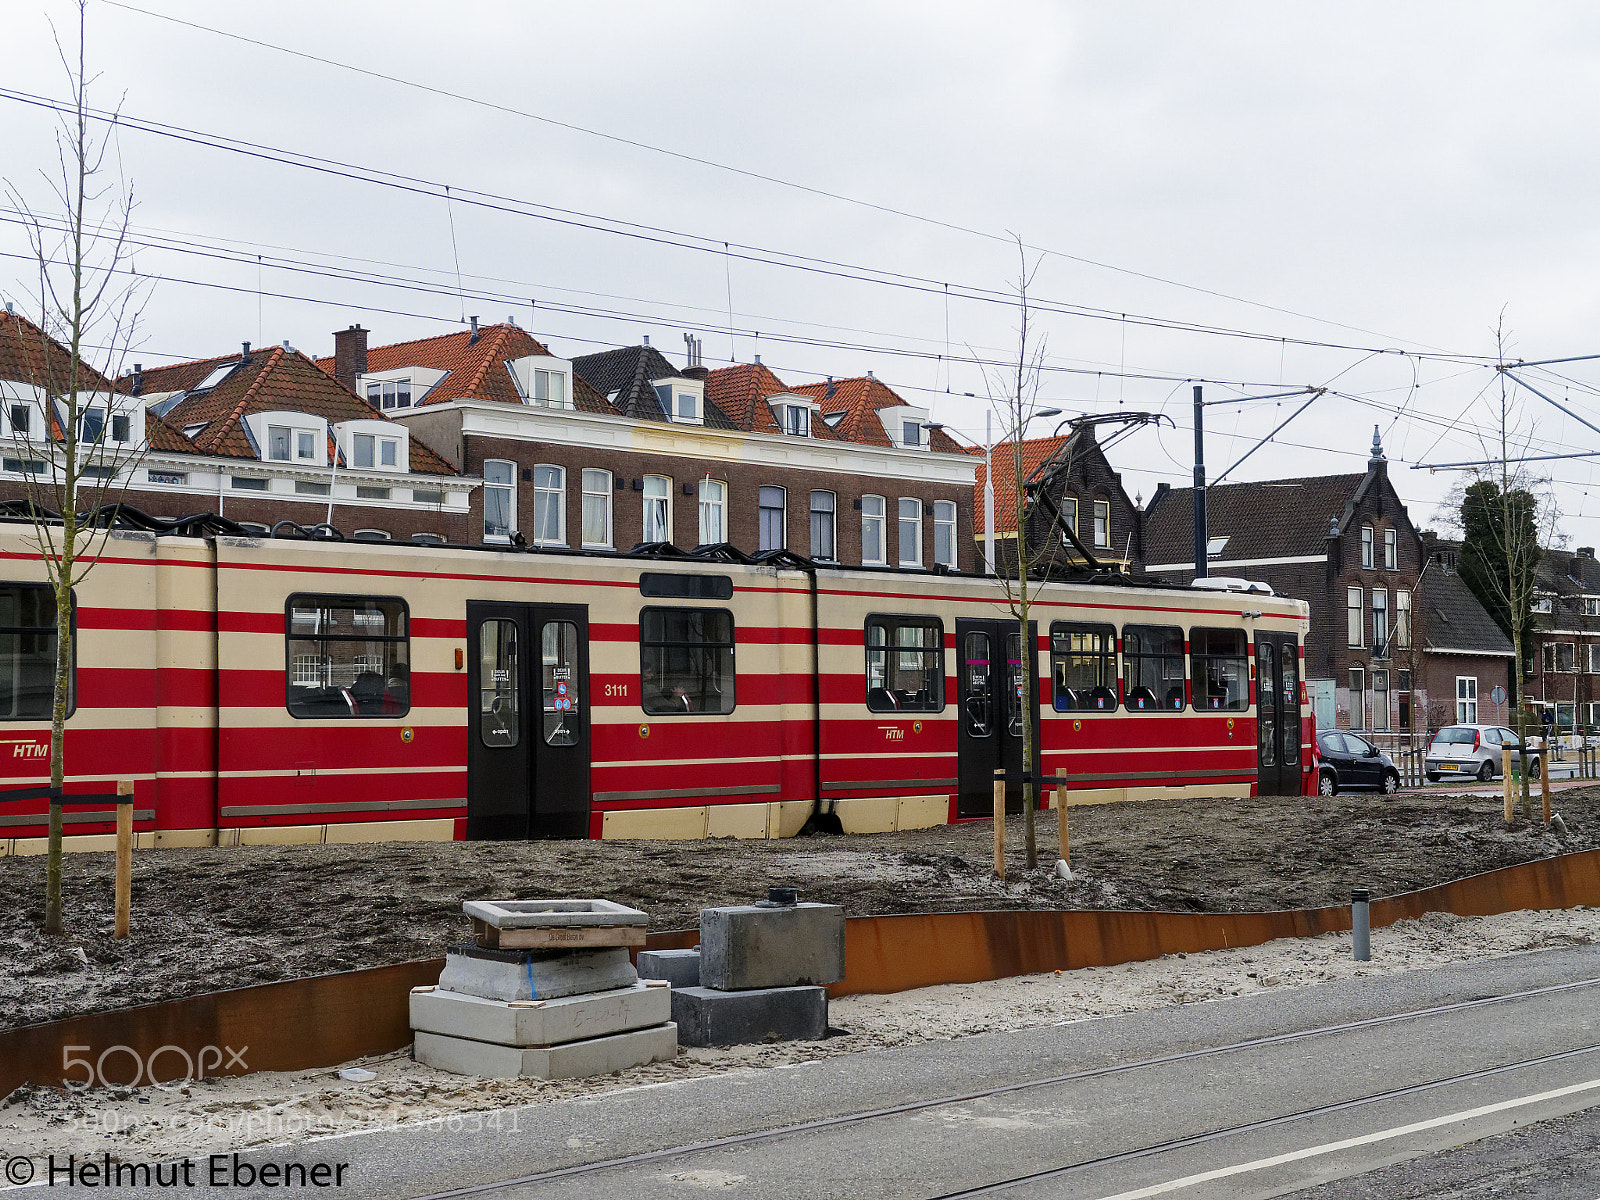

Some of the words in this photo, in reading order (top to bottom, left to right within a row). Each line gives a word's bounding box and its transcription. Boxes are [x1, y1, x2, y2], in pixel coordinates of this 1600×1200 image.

[604, 683, 628, 697] 3111
[885, 729, 904, 740] HTM
[13, 744, 48, 758] HTM
